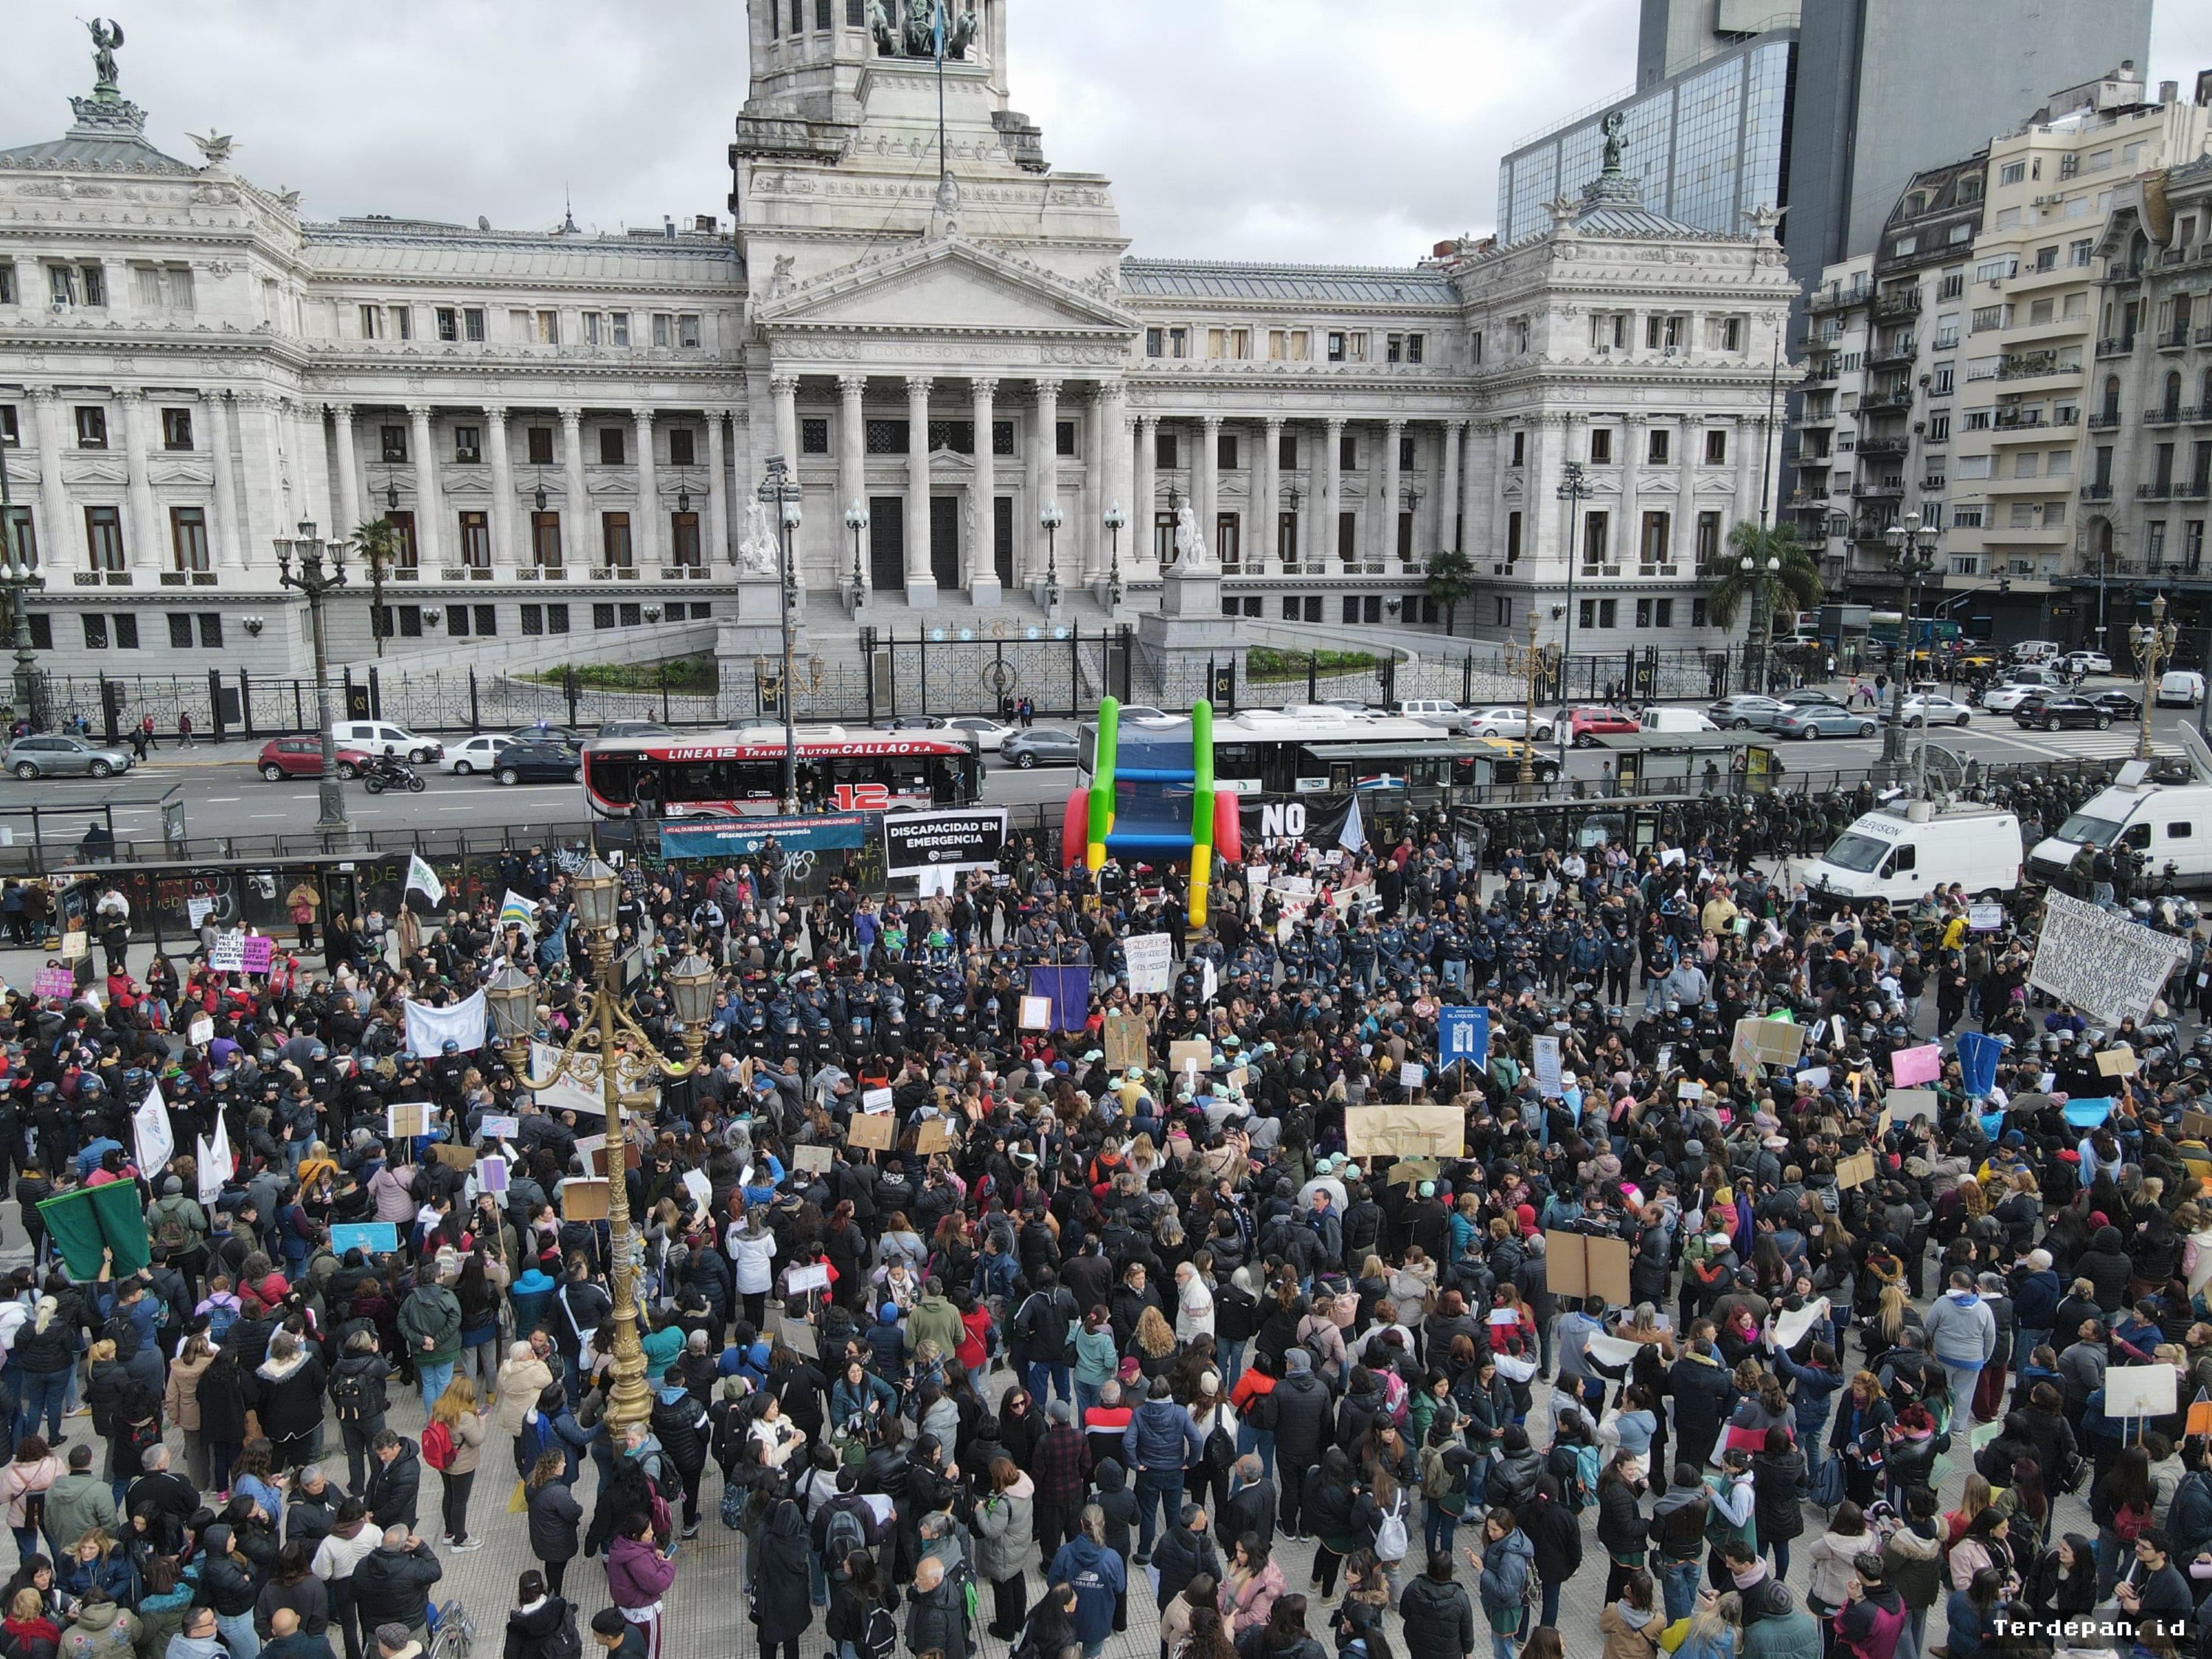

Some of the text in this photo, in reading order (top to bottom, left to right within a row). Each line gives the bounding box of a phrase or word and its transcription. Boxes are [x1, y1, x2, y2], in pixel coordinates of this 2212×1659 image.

[668, 748, 713, 759] LINEA
[717, 748, 737, 757] 12
[841, 743, 910, 754] CALLAO
[665, 805, 684, 815] 12
[834, 783, 889, 811] 12
[890, 821, 998, 838] DISCAPACIDAD EN
[1262, 803, 1306, 836] NO
[1854, 818, 1903, 836] TELEVISION
[906, 834, 983, 848] EMERGENCIA
[2048, 897, 2103, 925] PRESIDENTE
[2118, 928, 2178, 954] ARGENTINA
[2049, 888, 2065, 900] POR
[2067, 898, 2112, 921] MANDATO
[2112, 918, 2146, 934] DIVINO
[2148, 931, 2175, 945] SERE
[2050, 908, 2067, 921] SOY
[2067, 917, 2092, 931] JUAN
[2109, 933, 2167, 961] MENSAJERO
[2060, 928, 2114, 956] PRESIDENTE
[2062, 921, 2080, 934] DIOS
[2084, 931, 2106, 944] DICE
[2045, 929, 2158, 983] TRA NACION JAVIER MILEI
[2070, 947, 2096, 964] FALSO
[2038, 957, 2059, 973] GRAN
[2062, 967, 2093, 987] CIUDAD
[2110, 990, 2126, 1003] LOS
[2039, 950, 2079, 973] NACIONAL
[2081, 968, 2136, 998] WASHINGTON
[2067, 955, 2087, 969] BAJA
[2090, 964, 2107, 978] DEL
[2110, 974, 2154, 997] GOBIERNO
[2035, 970, 2067, 992] AMERICA
[2070, 987, 2094, 1004] TIENE
[2096, 998, 2113, 1013] LOS
[2036, 963, 2070, 984] ESTADOS
[2072, 980, 2104, 1000] UNIDOS
[2119, 1002, 2145, 1018] NORTE
[2060, 991, 2105, 1017] CONTADOS
